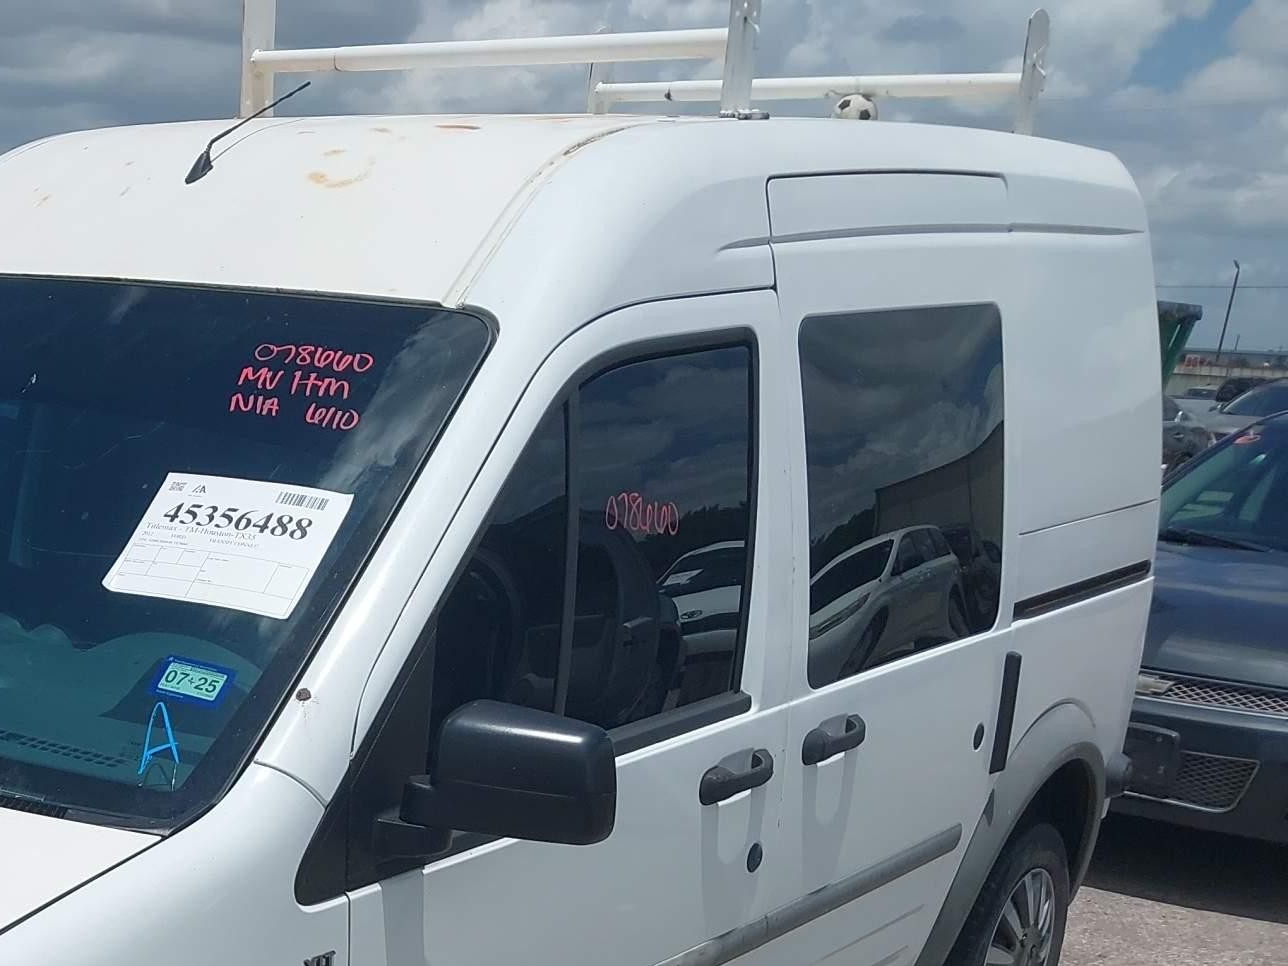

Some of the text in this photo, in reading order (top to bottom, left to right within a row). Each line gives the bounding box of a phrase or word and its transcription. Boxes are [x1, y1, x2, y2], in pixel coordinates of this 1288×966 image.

[254, 343, 375, 373] 078660
[163, 501, 313, 541] 45356488
[605, 491, 679, 536] 078660
[137, 701, 180, 776] A
